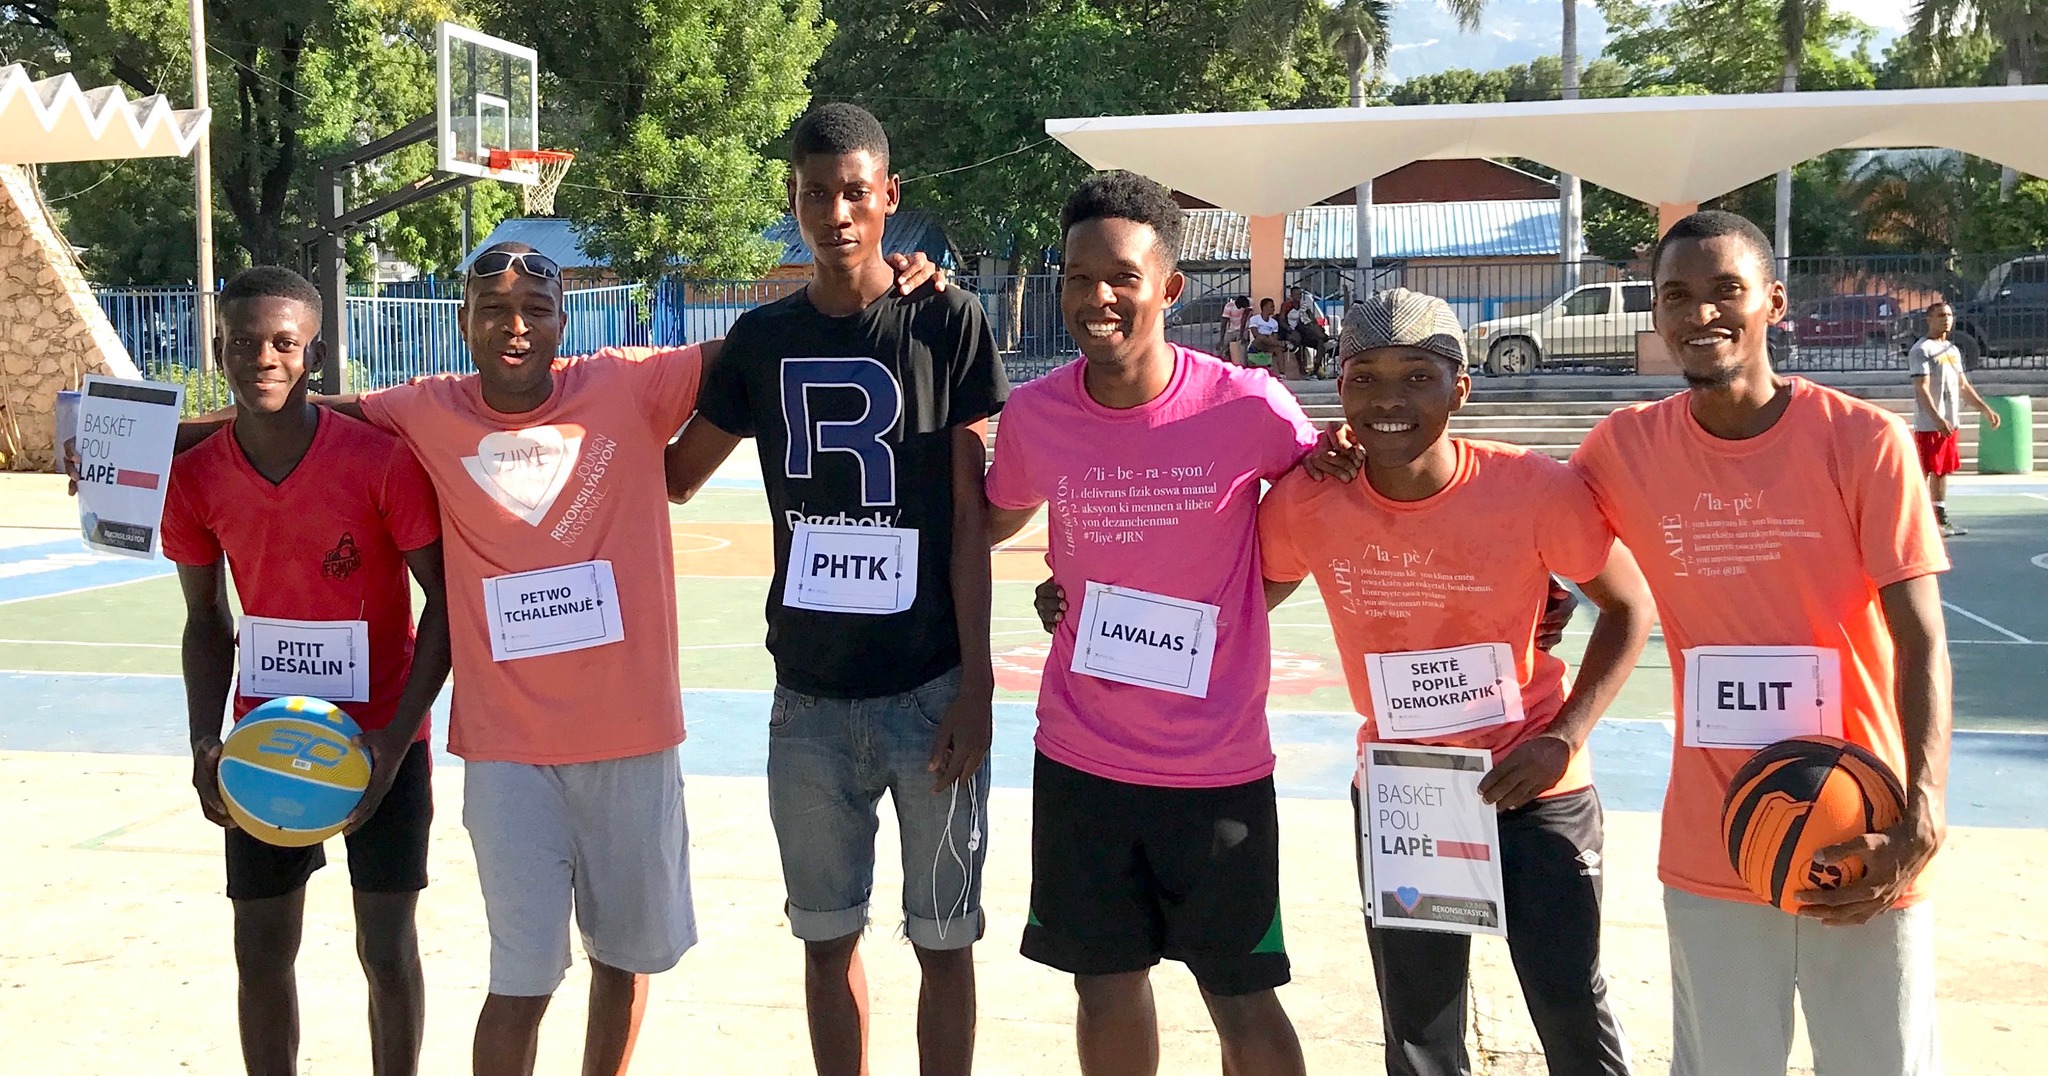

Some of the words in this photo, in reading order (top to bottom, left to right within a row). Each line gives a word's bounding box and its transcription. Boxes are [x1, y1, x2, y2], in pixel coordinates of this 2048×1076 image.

[84, 413, 137, 437] BASKÈT
[81, 437, 111, 460] POU
[576, 433, 608, 481] JOUNEN
[79, 463, 116, 484] LAPÈ
[550, 439, 617, 541] REKONSILYASYON
[1081, 487, 1127, 499] delivrans
[1129, 486, 1151, 497] fizik
[1153, 488, 1180, 496] oswa
[1182, 482, 1217, 494] mantal
[1082, 503, 1117, 517] aksyon
[1119, 502, 1129, 513] ki
[1131, 502, 1174, 513] mennen
[1082, 519, 1100, 530] yon
[1102, 516, 1179, 528] dezanchenman
[1115, 531, 1144, 544] #JRN
[1658, 513, 1689, 577] LAPÈ
[811, 553, 888, 581] PHTK
[521, 586, 571, 605] PETWO
[1328, 558, 1357, 615] LAPÈ
[504, 597, 594, 623] TCHALENNJÈ
[1101, 621, 1185, 652] LAVALAS
[278, 640, 324, 658] PITIT
[261, 656, 343, 675] DESALIN
[1411, 658, 1460, 675] SEKTÈ
[1412, 674, 1468, 692] POPILÈ
[1391, 685, 1495, 710] DEMOKRATIK
[1717, 681, 1793, 710] ELIT
[1377, 782, 1446, 807] BASKÈT
[1379, 809, 1420, 830] POU
[1380, 833, 1434, 857] LAPÈ
